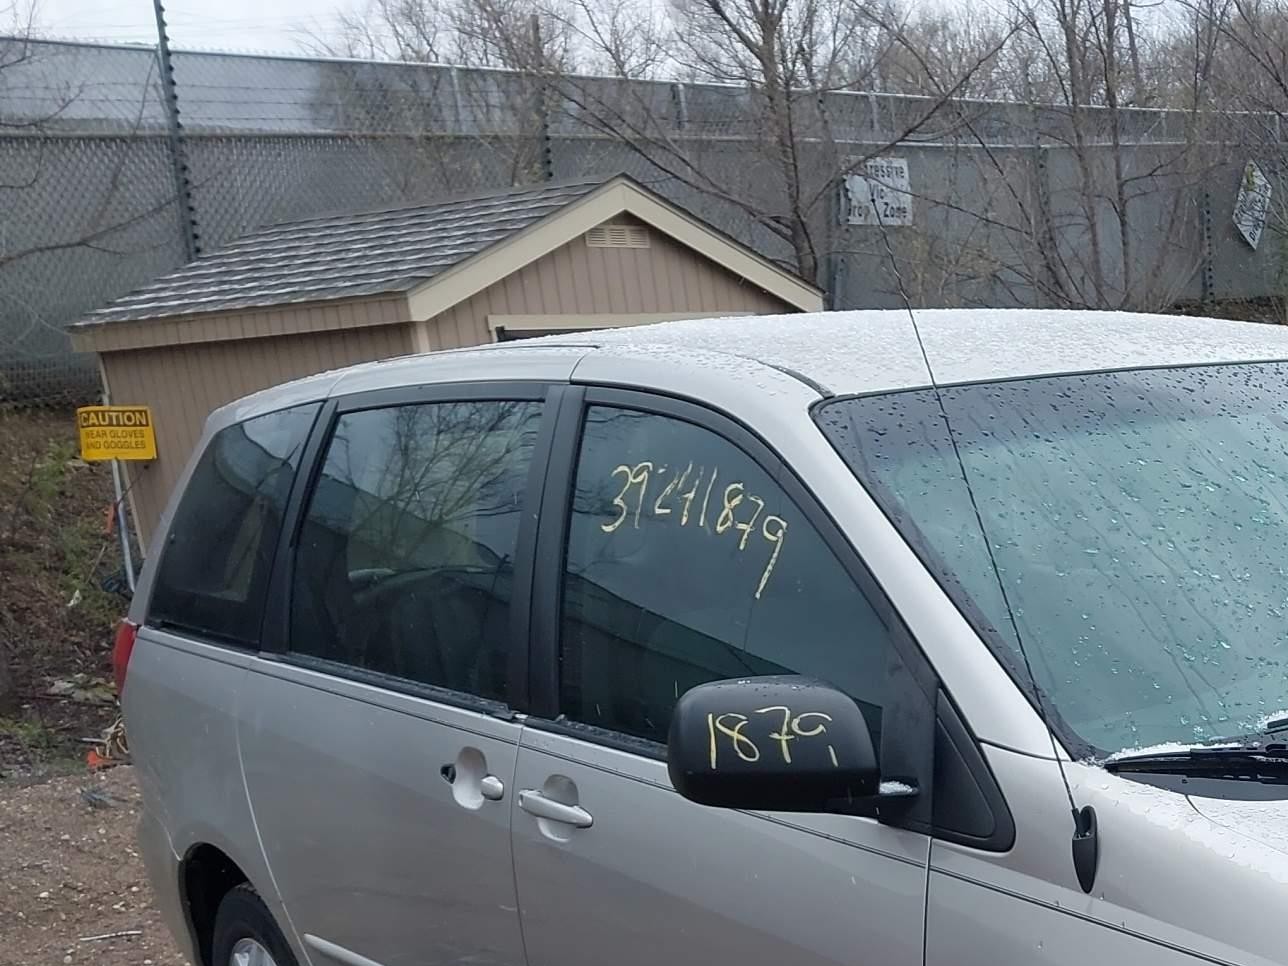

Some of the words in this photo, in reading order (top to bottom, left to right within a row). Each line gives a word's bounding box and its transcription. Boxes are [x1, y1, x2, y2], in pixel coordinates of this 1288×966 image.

[81, 411, 147, 426] CAUTION
[109, 429, 145, 438] GLOVES
[103, 440, 146, 449] GOGGLES
[601, 459, 788, 600] 39241879
[707, 706, 839, 770] 1879
